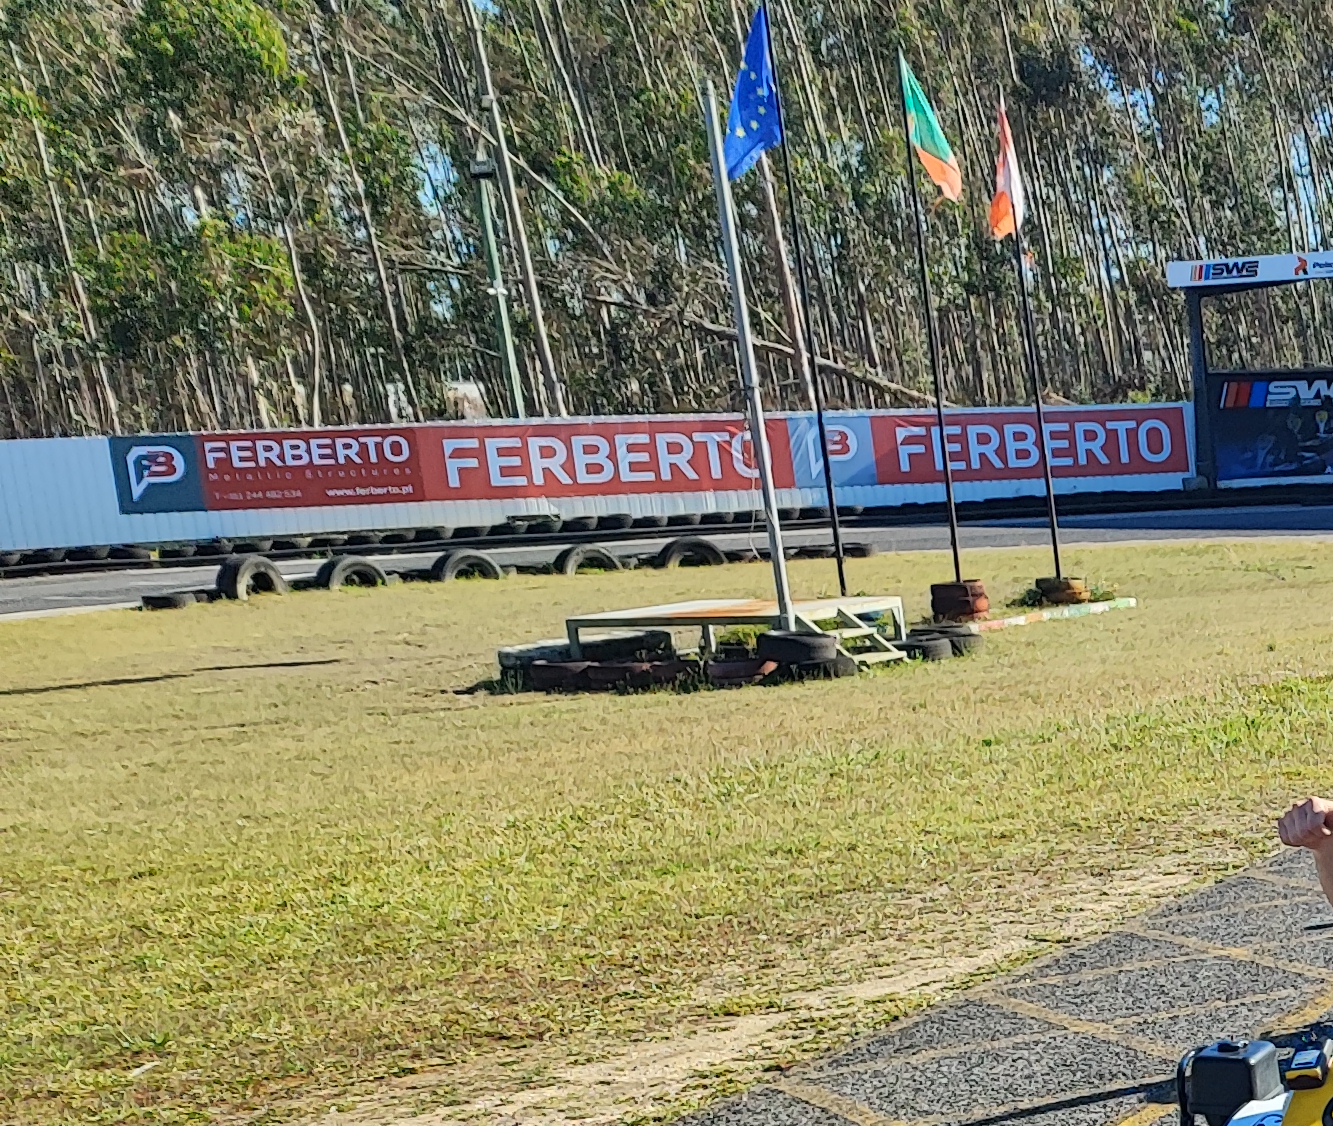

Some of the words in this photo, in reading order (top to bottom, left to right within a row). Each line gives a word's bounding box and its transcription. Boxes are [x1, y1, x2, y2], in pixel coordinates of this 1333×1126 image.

[203, 434, 411, 469] FERBERTO
[895, 418, 1172, 473] FERBERTO
[325, 483, 414, 497] www.ferberto.pt
